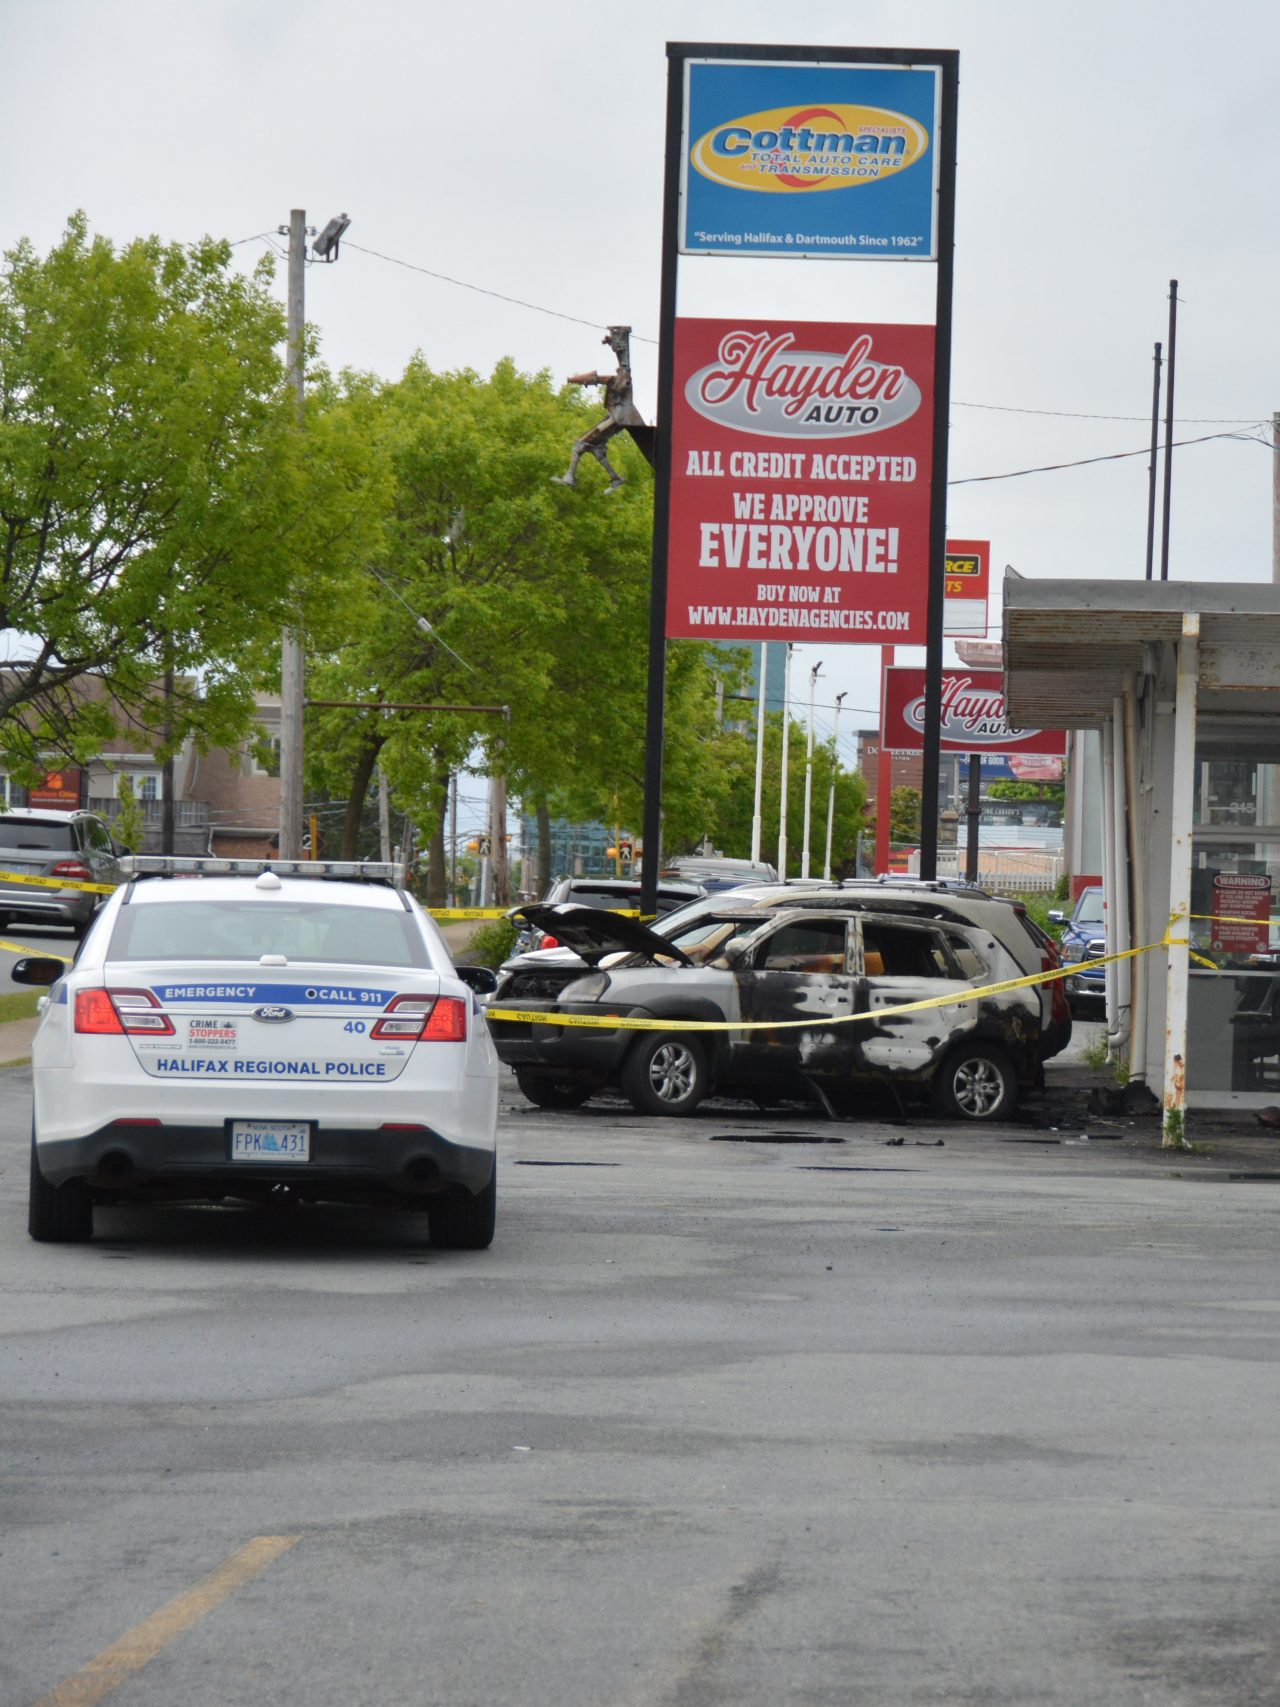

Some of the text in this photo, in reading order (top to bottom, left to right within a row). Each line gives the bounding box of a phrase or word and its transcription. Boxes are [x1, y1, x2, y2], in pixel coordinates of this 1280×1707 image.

[858, 126, 906, 134] SPECIALISTS
[711, 126, 906, 157] Cottman
[751, 152, 902, 167] TOTAL AUTO CARE
[759, 164, 879, 177] TRANSMISSION
[744, 232, 783, 244] Halifax
[785, 234, 794, 243] &
[796, 233, 857, 245] Dartmouth
[859, 235, 888, 246] Since
[699, 330, 905, 419] Hayden
[803, 405, 879, 424] AUTO
[686, 450, 917, 482] ALL CREDIT ACCEPTED
[733, 492, 869, 523] WE APPROVE
[699, 522, 899, 574] EVERYONE!
[945, 560, 975, 573] RCE
[756, 584, 841, 603] BUY NOW AT
[946, 580, 963, 592] TS
[688, 606, 910, 630] WWW.HAYDENAGENCIES.COM
[1220, 876, 1266, 886] WARNING
[165, 987, 382, 1003] EMERGENCY CALL 911
[261, 1007, 287, 1018] Ford
[190, 1020, 218, 1029] CRIME
[343, 1021, 366, 1034] 40
[189, 1029, 236, 1038] STOPPERS
[157, 1058, 386, 1076] HALIFAX REGIONAL POLICE
[235, 1133, 306, 1152] FPK 431
